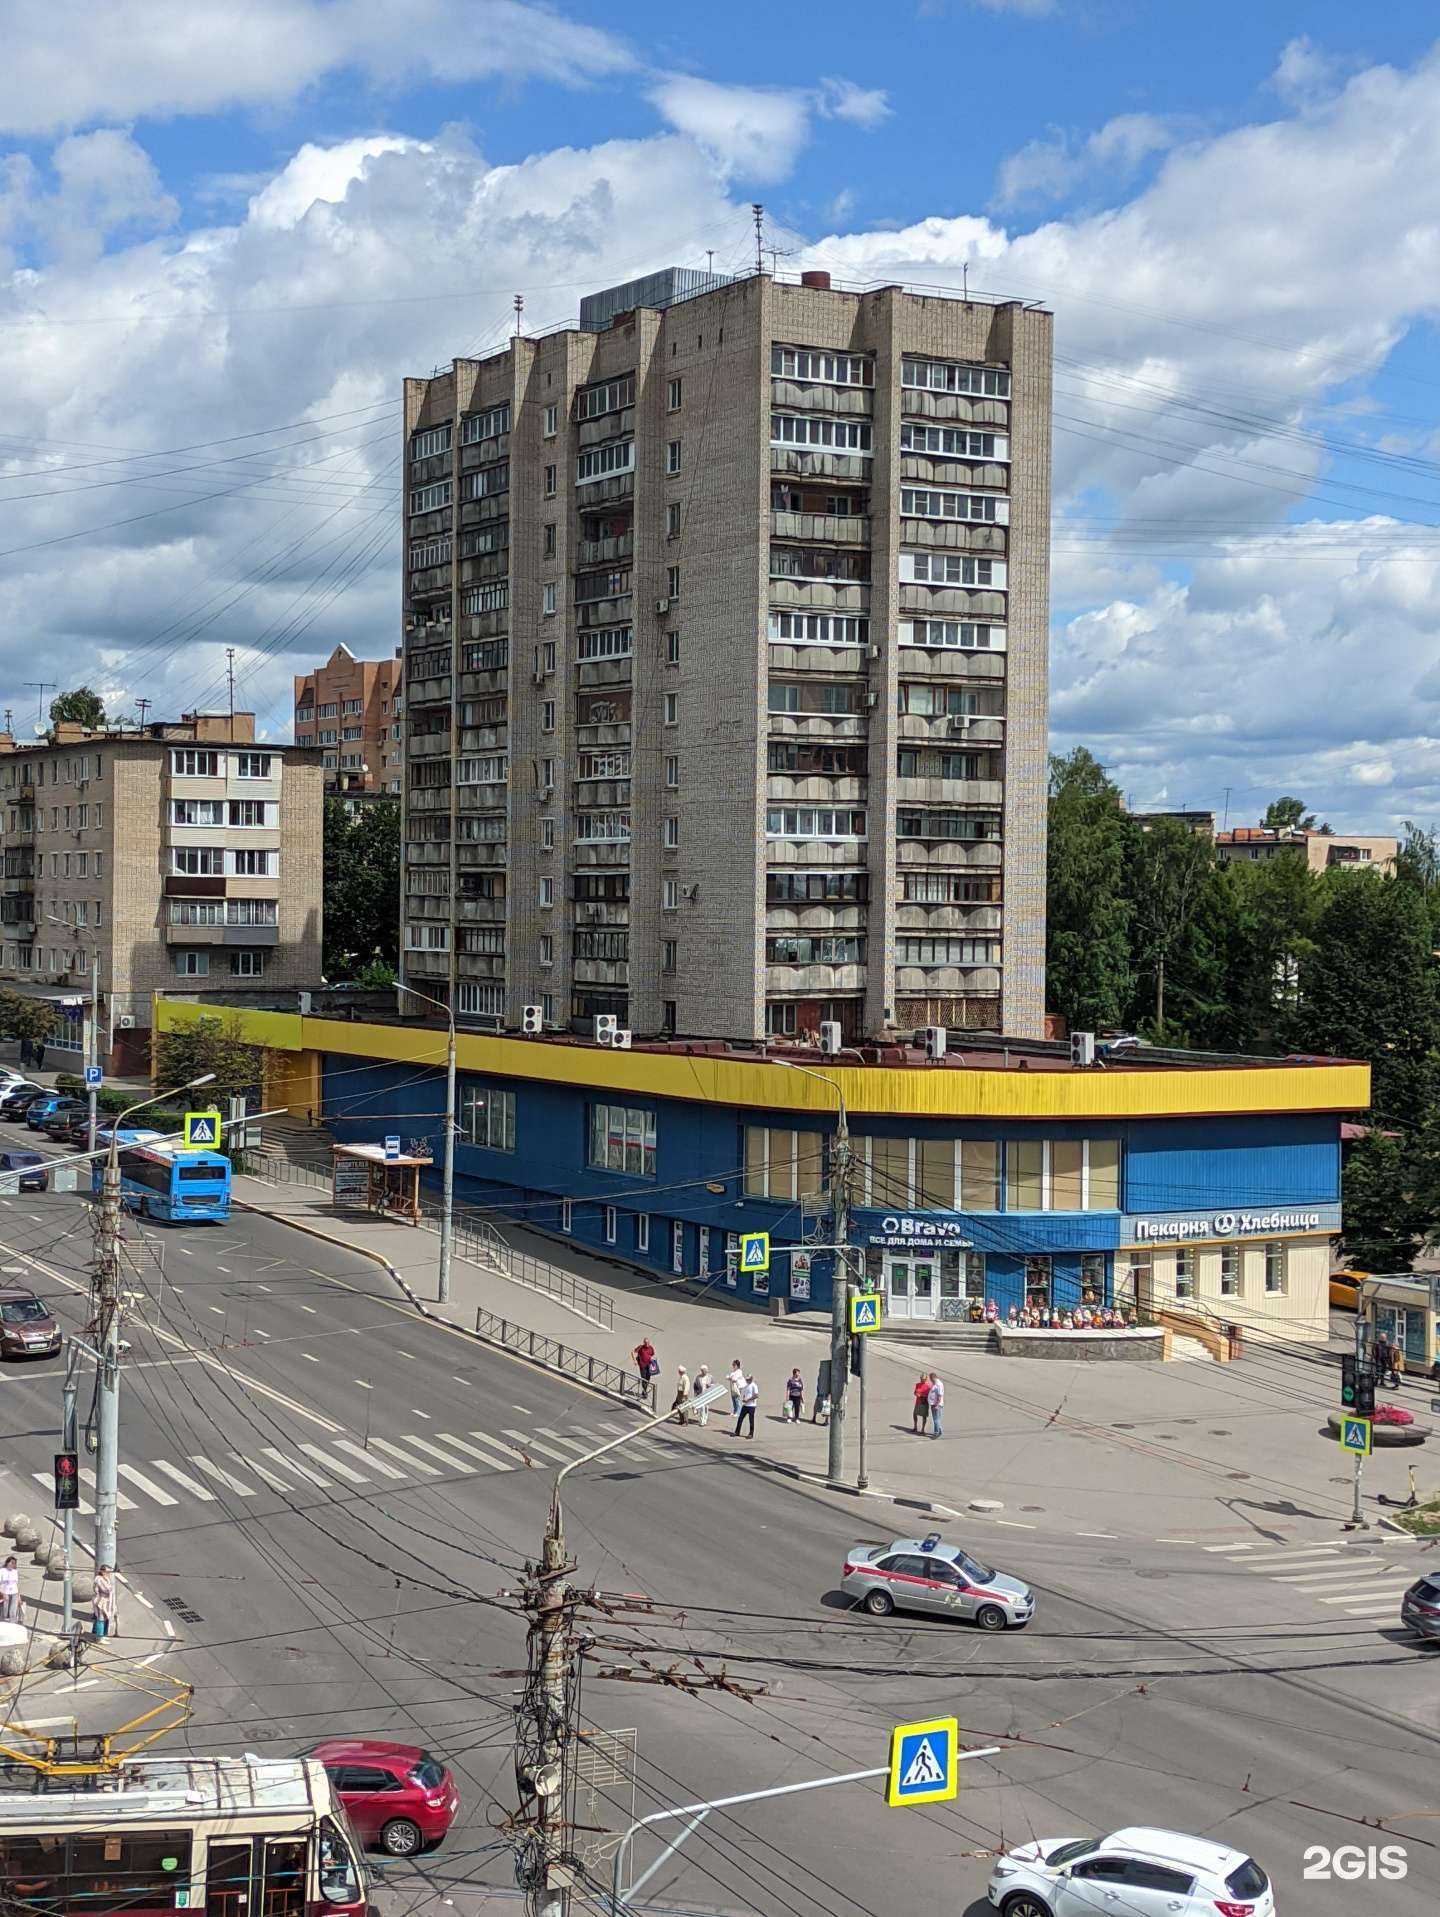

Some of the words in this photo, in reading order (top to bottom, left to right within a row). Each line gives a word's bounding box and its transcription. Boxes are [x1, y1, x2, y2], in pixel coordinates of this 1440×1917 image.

[901, 1218, 961, 1237] Bravo
[1137, 1219, 1209, 1240] Пекарня
[1240, 1212, 1320, 1231] Хлебница
[869, 1235, 886, 1244] ВСЕ
[887, 1237, 906, 1246] ДЛЯ
[907, 1238, 933, 1246] ДОМА
[935, 1238, 942, 1246] И
